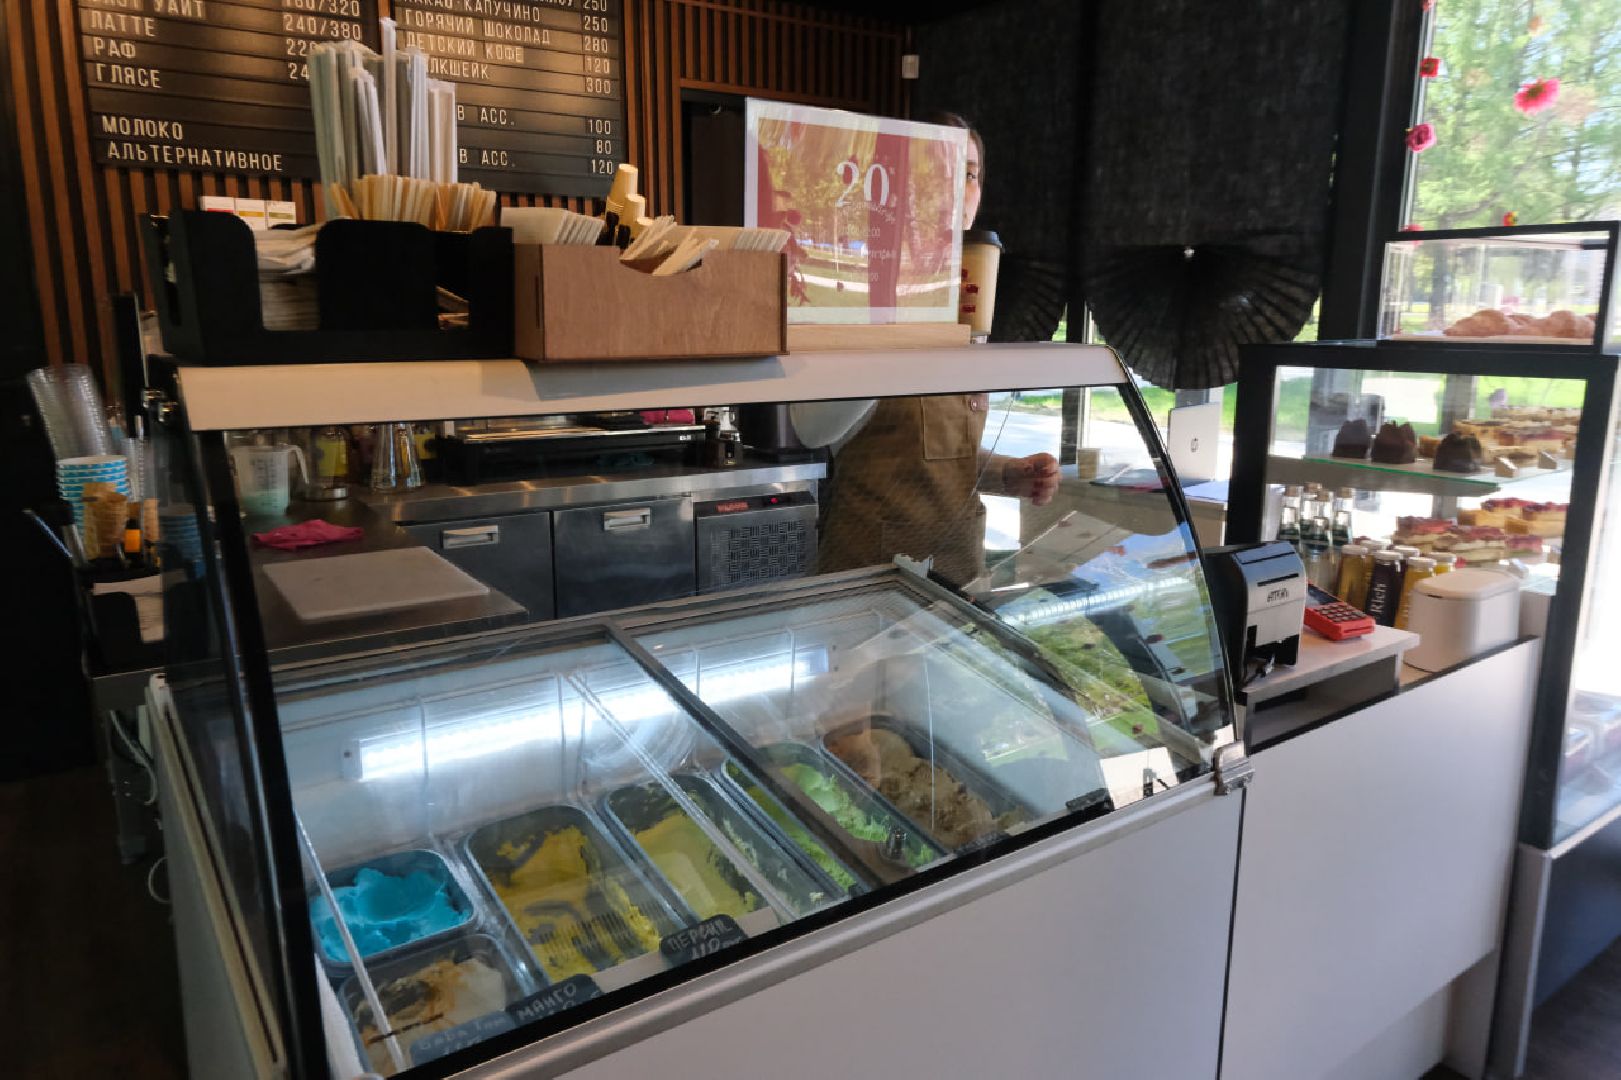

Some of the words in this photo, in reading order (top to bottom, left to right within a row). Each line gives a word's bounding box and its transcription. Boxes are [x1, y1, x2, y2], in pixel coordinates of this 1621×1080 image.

[91, 10, 156, 37] ЛАТТЕ
[283, 14, 361, 41] 240/380
[405, 9, 474, 36] ГОРЯЧИЙ
[484, 20, 550, 45] ШОКОЛАД
[584, 15, 608, 33] 250
[93, 37, 137, 59] РАФ
[406, 31, 476, 57] ДЕТСКИЙ
[486, 43, 523, 64] КОФЕ
[584, 35, 608, 54] 280
[95, 62, 161, 89] ГЛЯСЕ
[585, 57, 611, 74] 120
[586, 77, 611, 95] 300
[102, 115, 184, 141] МОЛОКО
[588, 119, 611, 135] 100
[107, 141, 283, 172] АЛЬТЕРНАТИВНОЕ
[596, 140, 612, 155] 80
[591, 159, 613, 175] 120
[1370, 583, 1388, 613] Rich
[517, 982, 577, 1021] МАНГО
